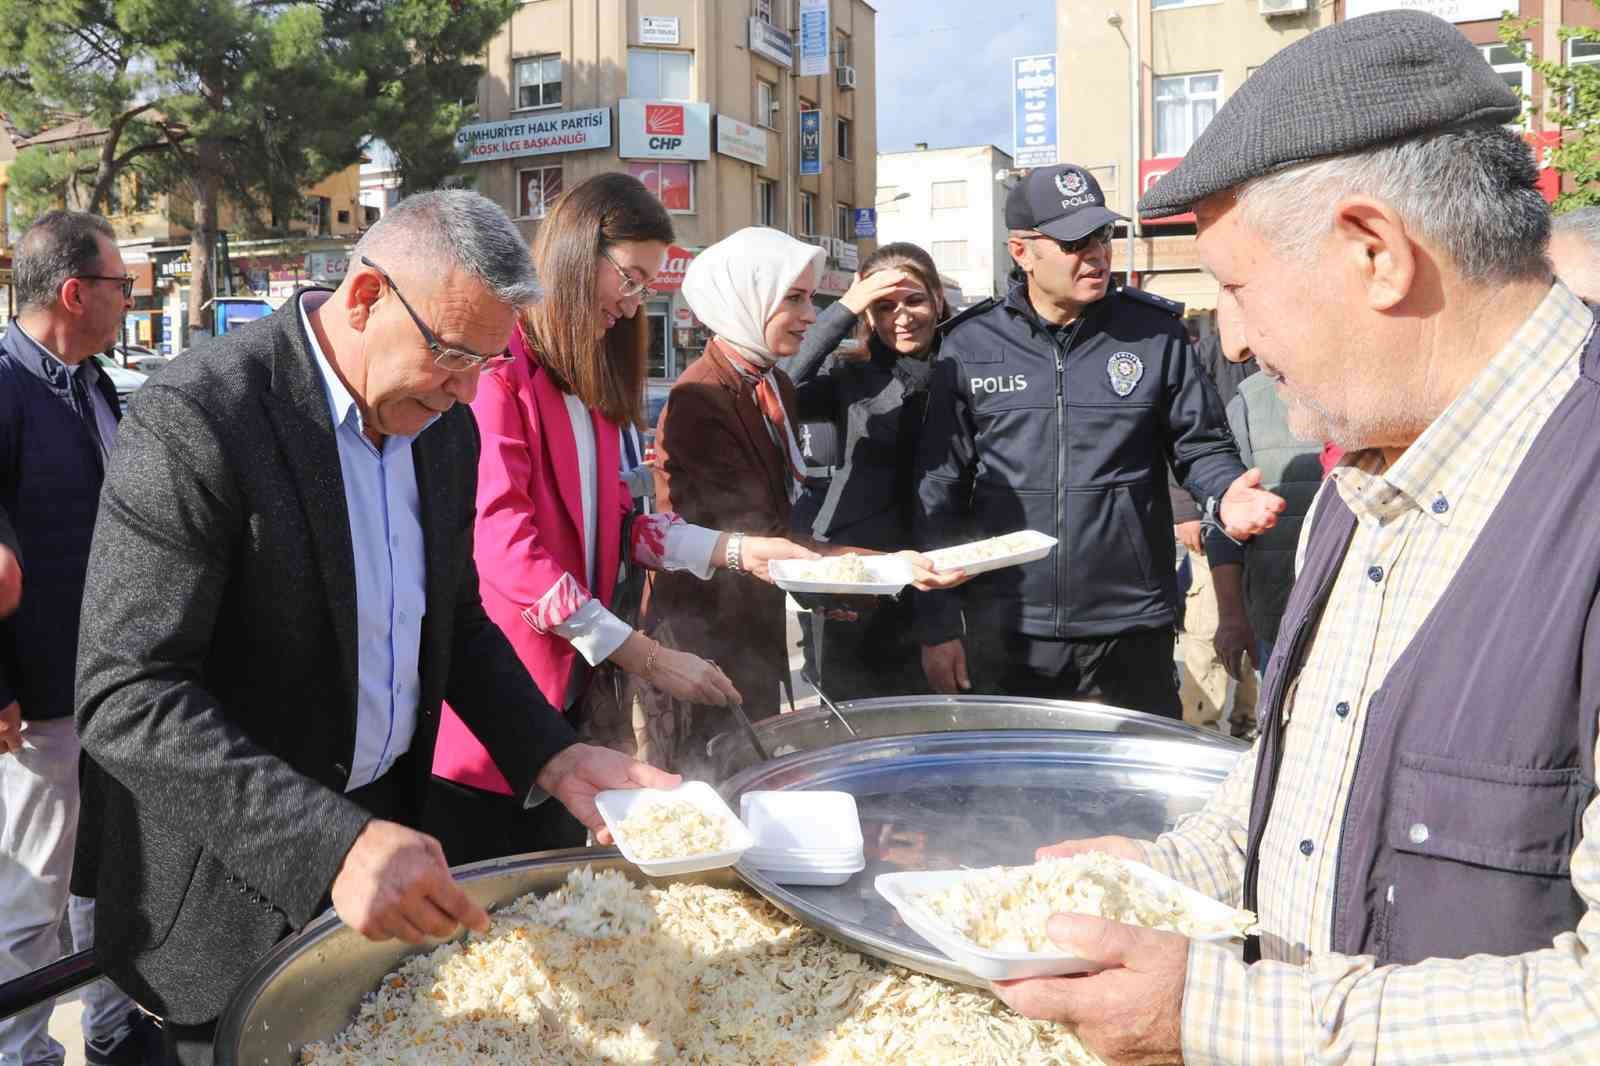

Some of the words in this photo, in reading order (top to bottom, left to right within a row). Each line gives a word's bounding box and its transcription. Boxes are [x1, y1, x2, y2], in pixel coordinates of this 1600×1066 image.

[457, 123, 525, 144] CUMHURİYET
[528, 120, 558, 134] HALK
[561, 111, 602, 130] PARTİSİ
[648, 136, 682, 151] CHP
